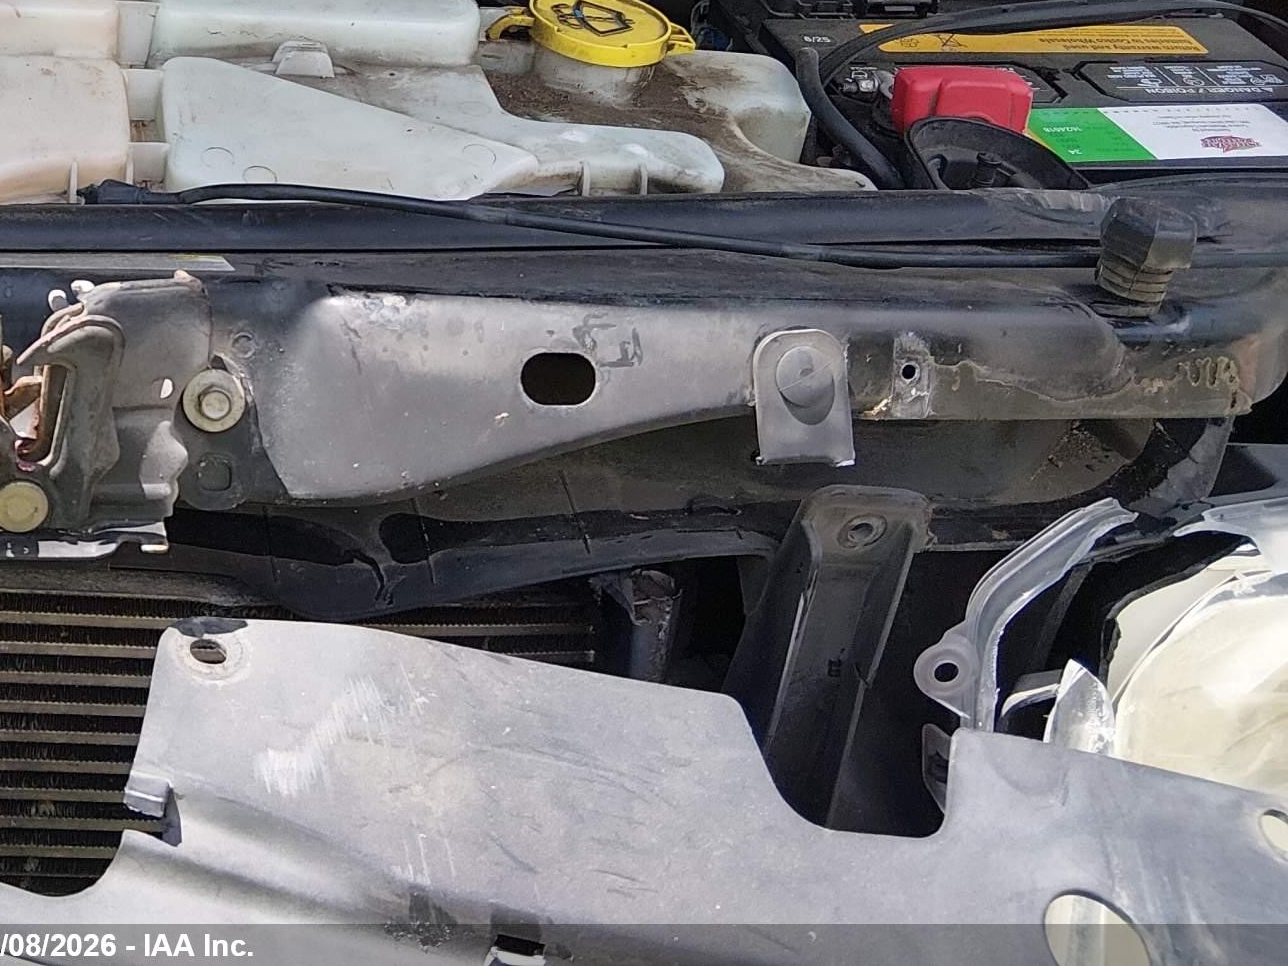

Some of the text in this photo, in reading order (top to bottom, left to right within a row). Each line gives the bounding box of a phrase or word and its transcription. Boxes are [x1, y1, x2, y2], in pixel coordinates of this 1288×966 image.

[1144, 37, 1192, 45] batteries
[1113, 44, 1162, 52] warranty
[1163, 44, 1201, 52] Return
